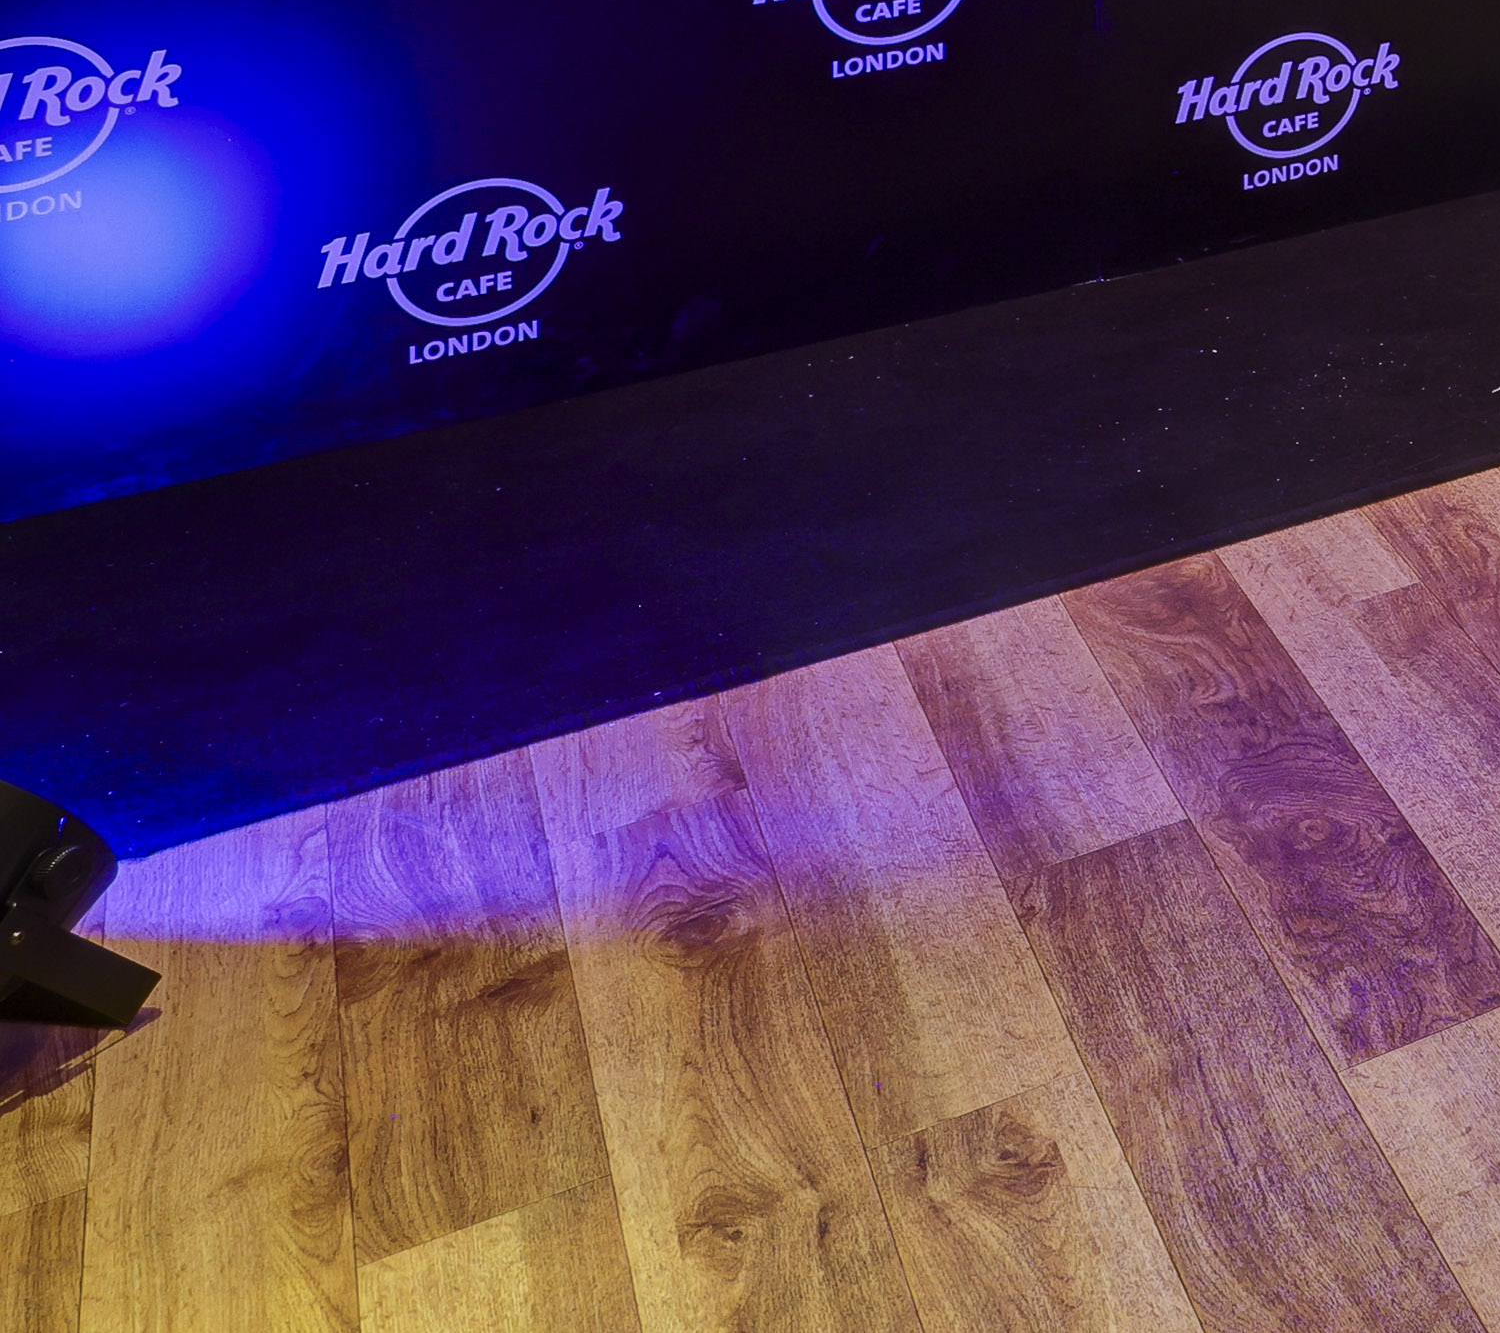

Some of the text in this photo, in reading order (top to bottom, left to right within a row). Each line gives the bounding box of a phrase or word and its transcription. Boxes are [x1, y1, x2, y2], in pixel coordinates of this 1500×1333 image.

[831, 41, 944, 79] LONDON
[16, 48, 182, 127] Rock
[1174, 41, 1400, 125] Hard Rock
[1262, 110, 1319, 138] CAFE
[0, 136, 53, 164] AFE
[1242, 153, 1339, 191] LONDON
[0, 190, 82, 223] DON
[316, 186, 624, 290] Hard Rock
[436, 269, 512, 303] CAFE
[408, 319, 538, 365] LONDON
